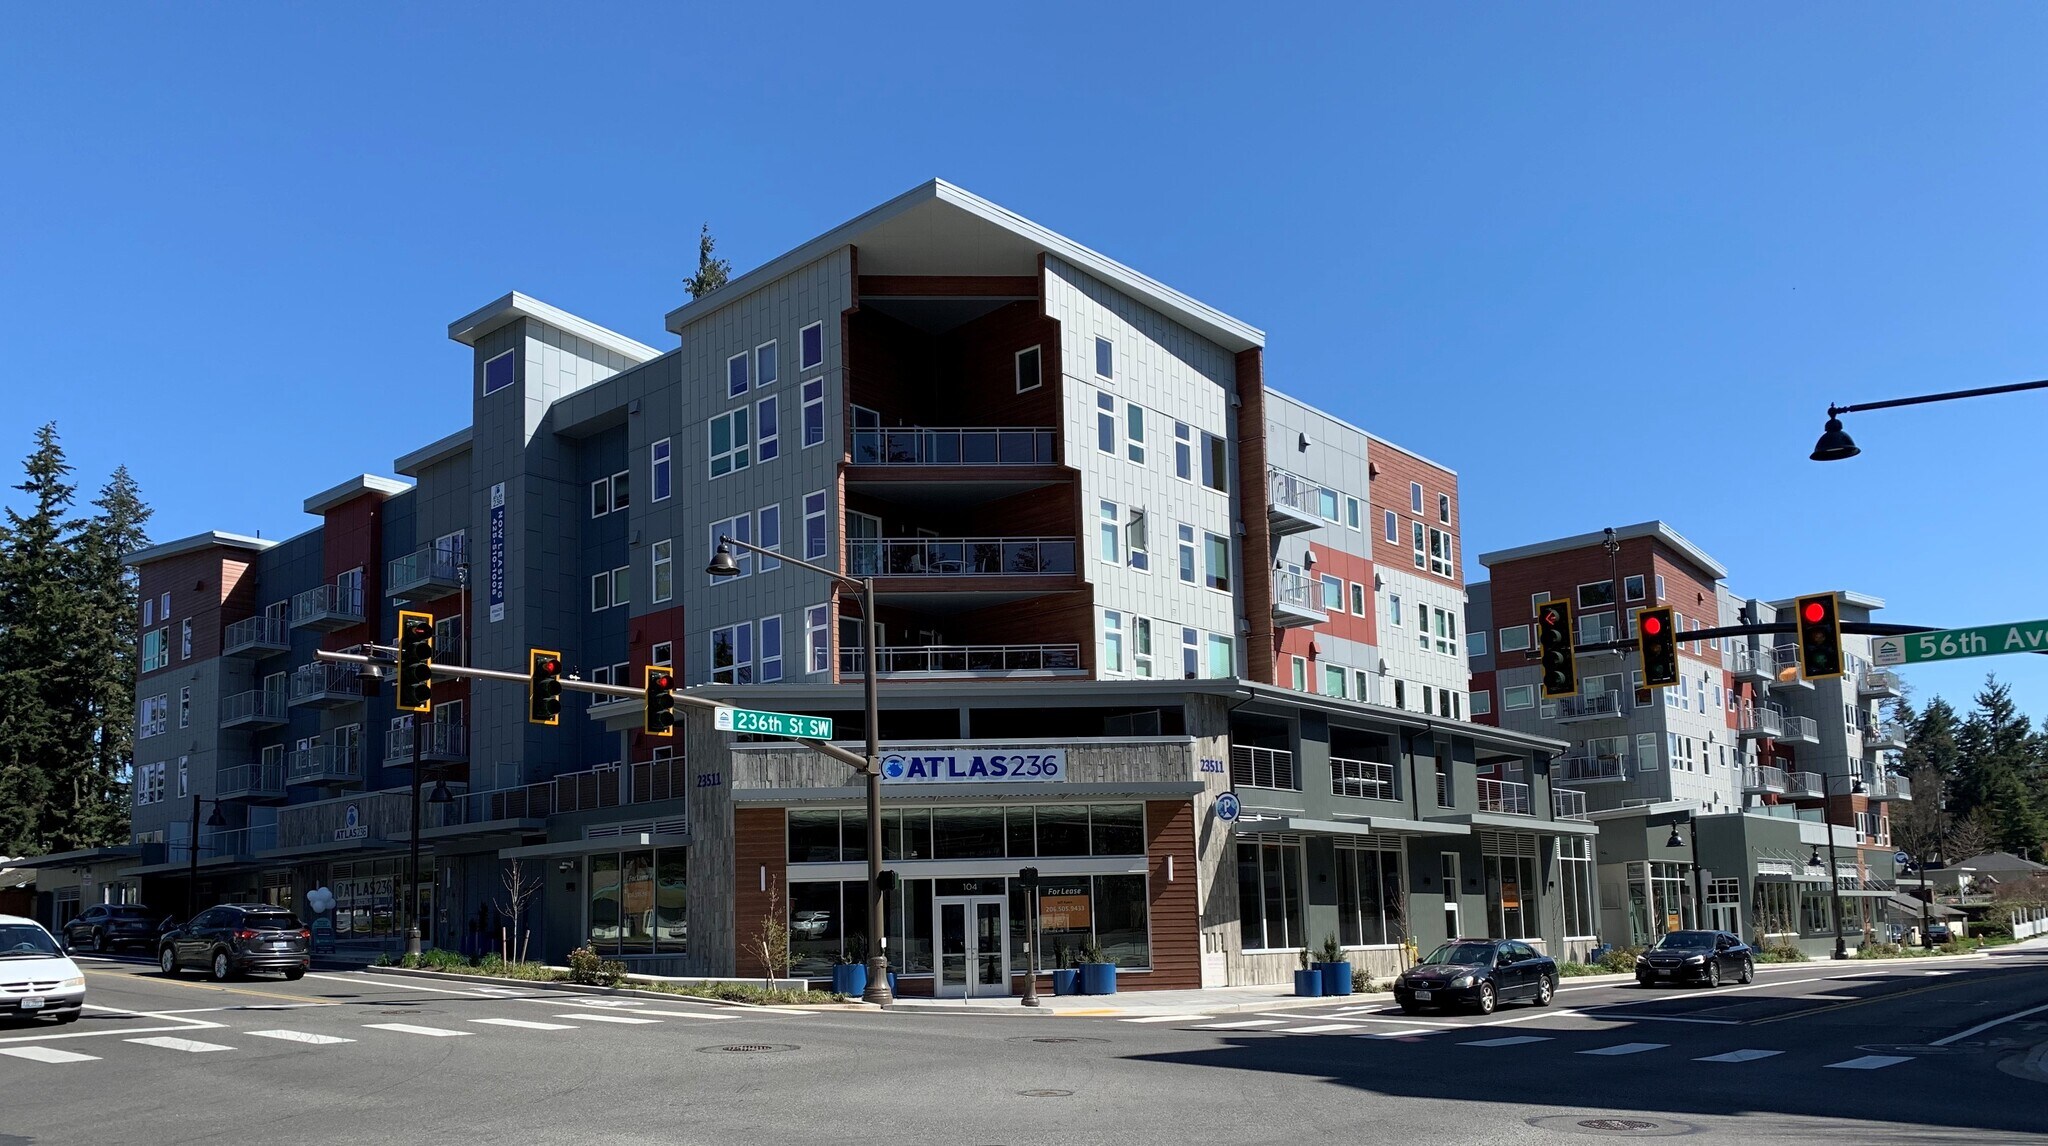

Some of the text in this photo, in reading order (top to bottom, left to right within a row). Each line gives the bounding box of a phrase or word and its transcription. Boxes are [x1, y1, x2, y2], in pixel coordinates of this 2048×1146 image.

[1919, 631, 1987, 659] 56th
[737, 712, 829, 737] 236th St SW
[907, 755, 1058, 778] ATLAS236
[1200, 759, 1224, 773] 23511
[697, 772, 721, 788] 23511
[1223, 799, 1231, 812] P
[336, 827, 367, 840] ATLAS236
[344, 879, 392, 897] ATLAS236
[963, 883, 977, 891] 104
[1061, 887, 1082, 895] Lease
